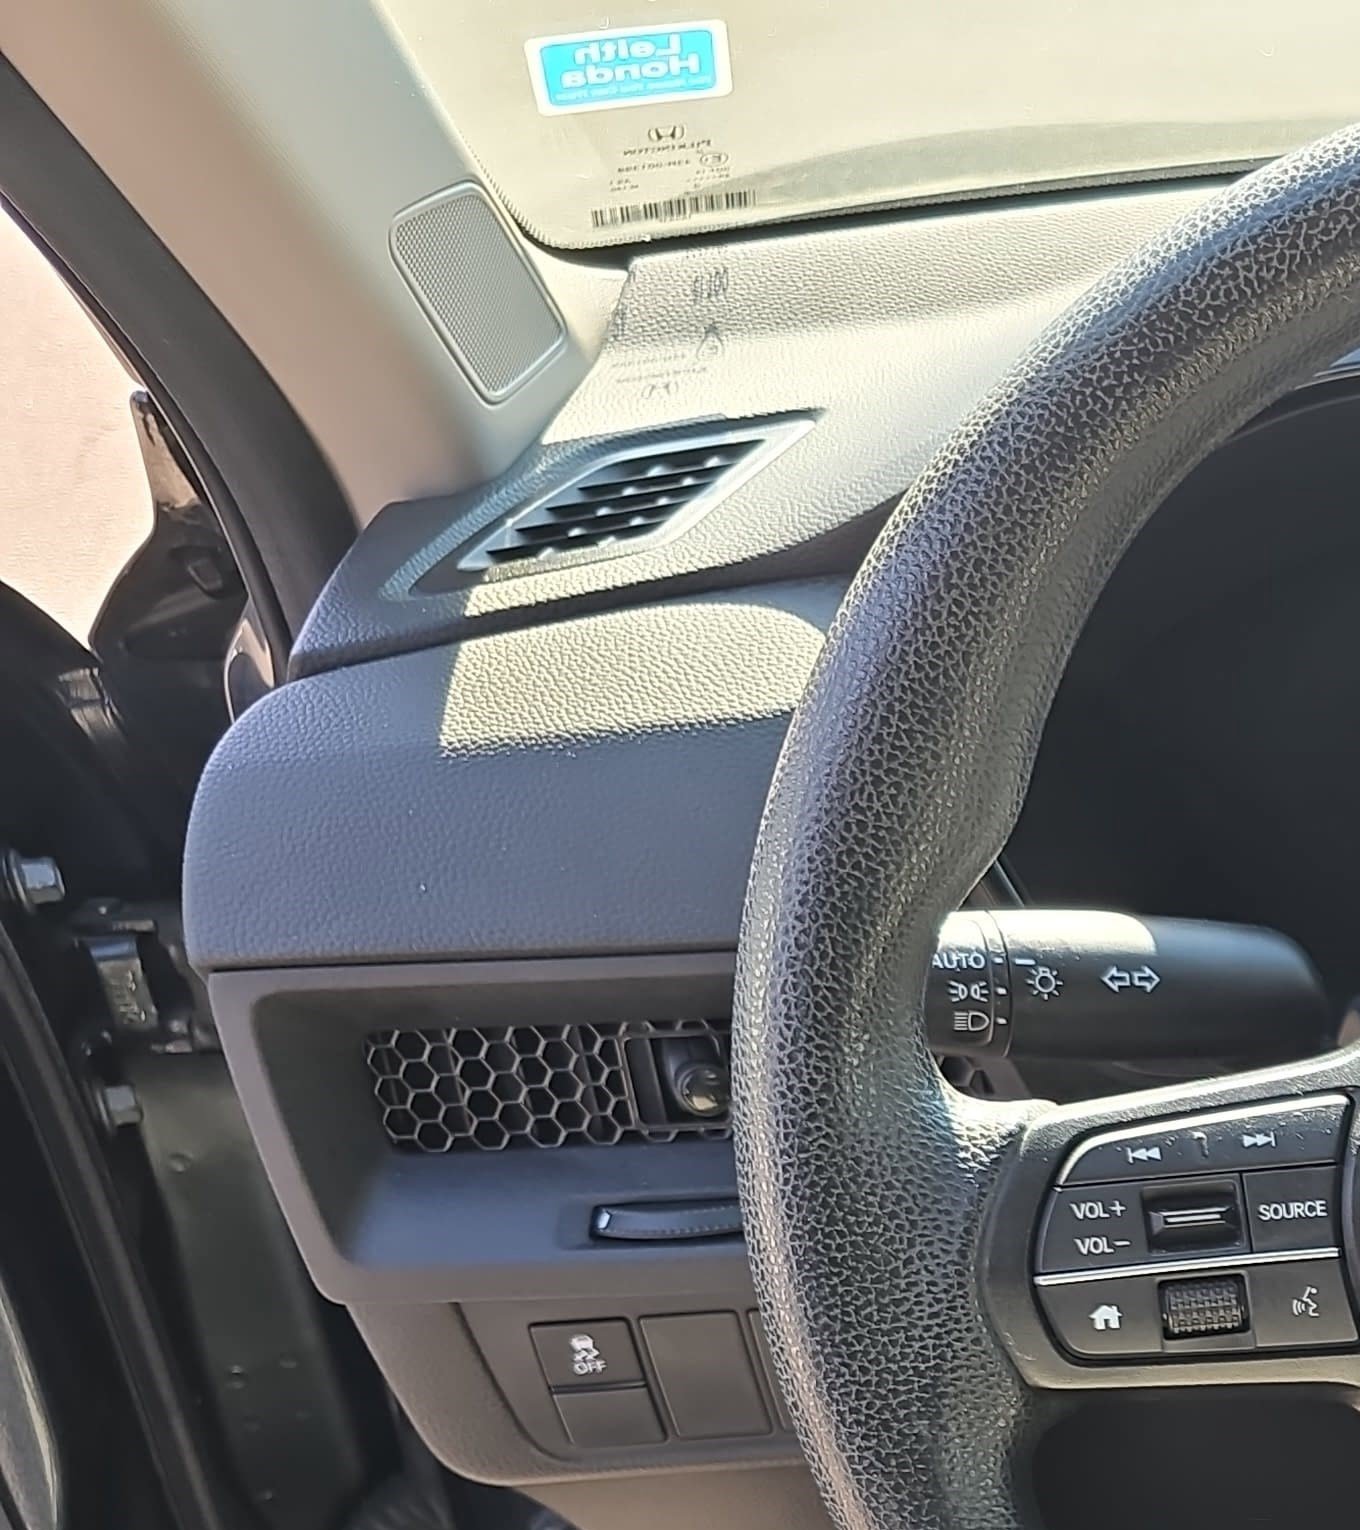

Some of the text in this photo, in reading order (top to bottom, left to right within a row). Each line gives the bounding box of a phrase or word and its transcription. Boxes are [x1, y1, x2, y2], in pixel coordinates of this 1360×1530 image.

[931, 952, 987, 971] AUTO
[1257, 1200, 1329, 1221] SOURCE
[572, 1359, 608, 1376] OFF
